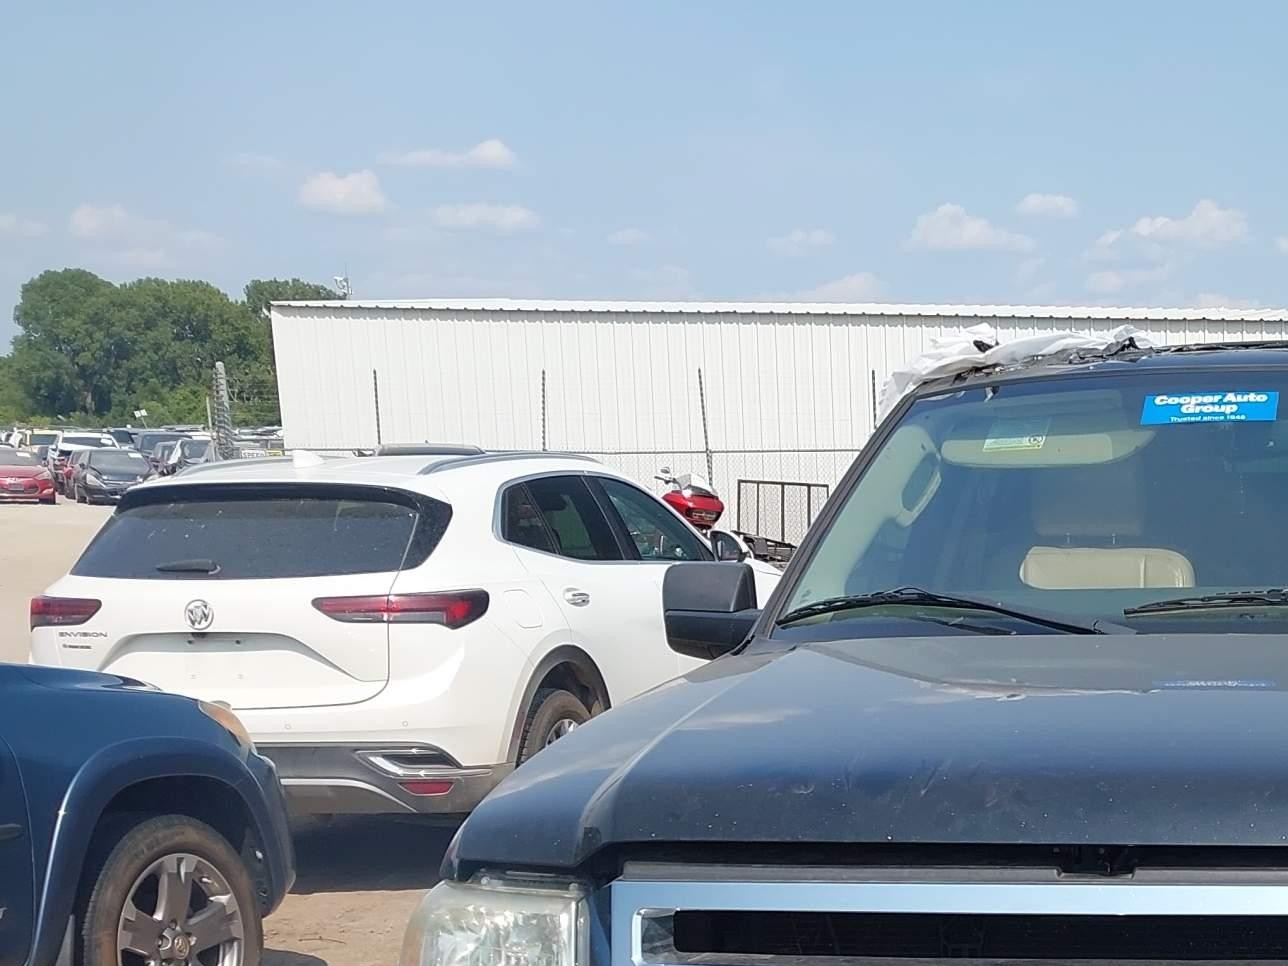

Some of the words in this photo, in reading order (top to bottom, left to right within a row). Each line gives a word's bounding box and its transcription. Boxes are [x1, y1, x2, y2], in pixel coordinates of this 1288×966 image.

[1154, 395, 1222, 406] Cooper
[1223, 393, 1268, 403] Auto
[1180, 404, 1238, 414] Group
[1170, 415, 1201, 423] Trusted
